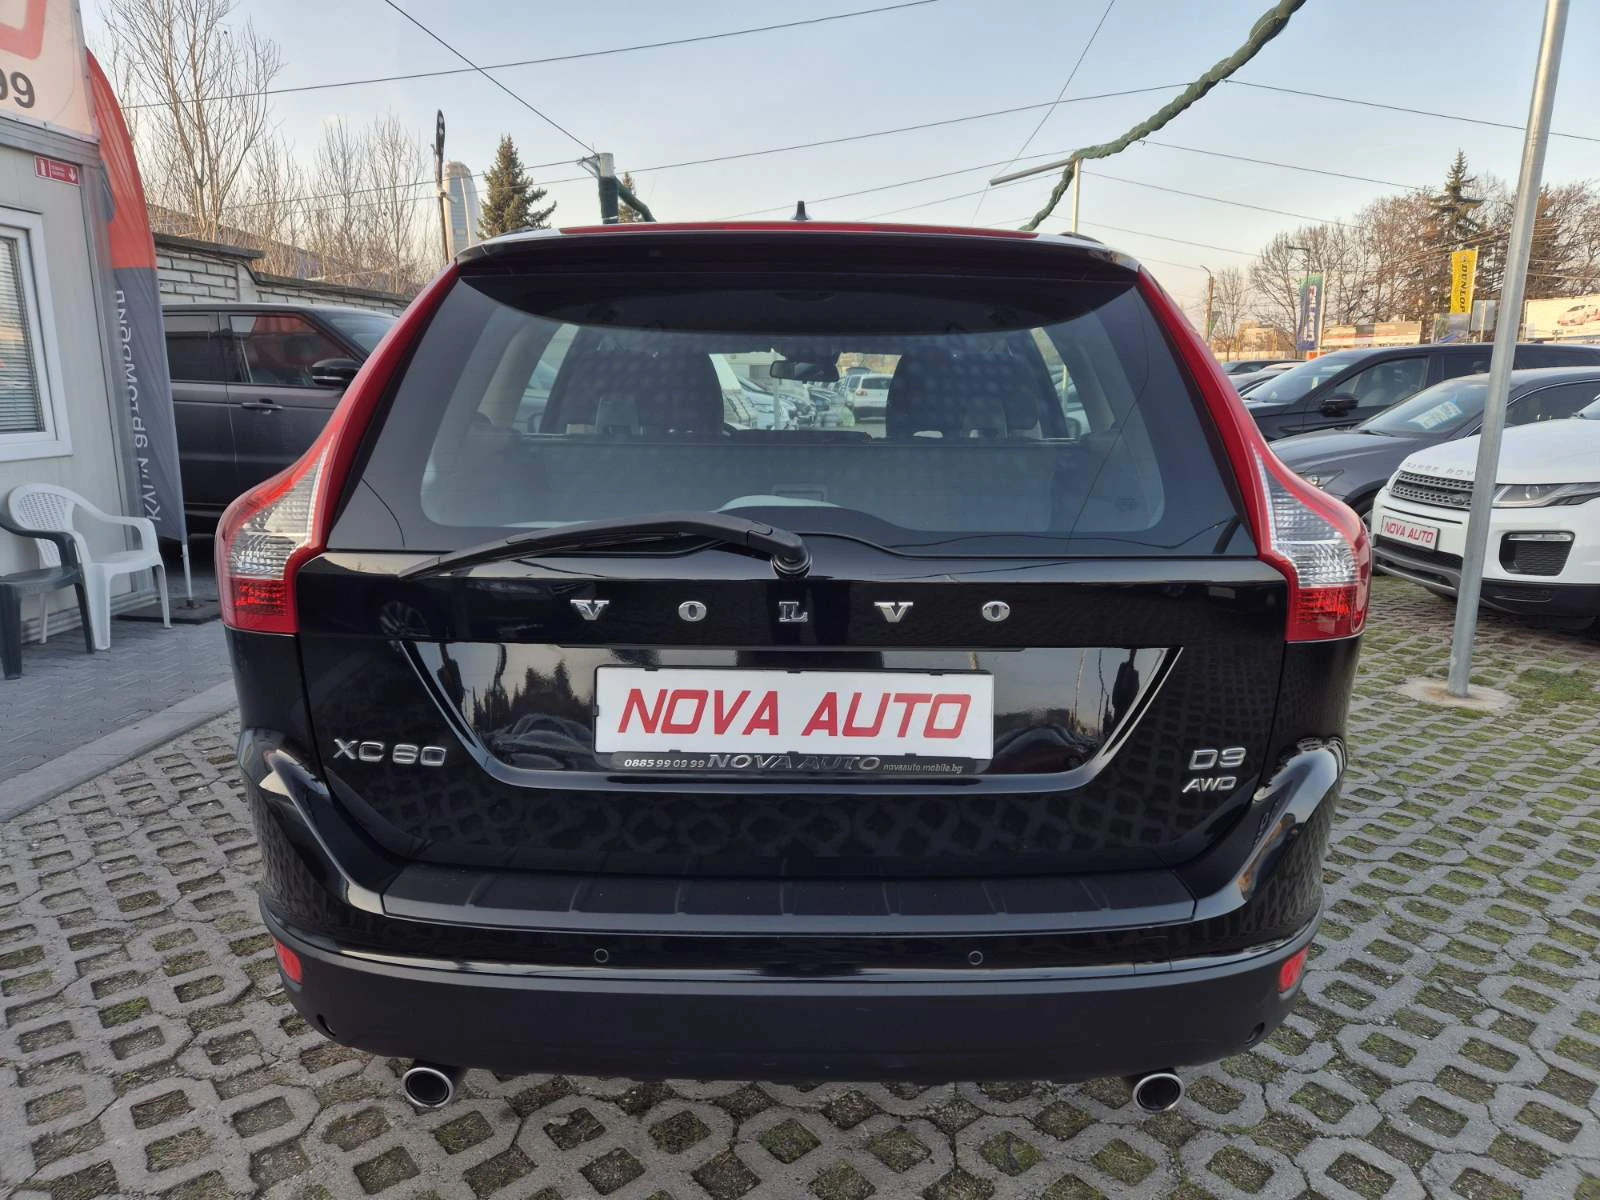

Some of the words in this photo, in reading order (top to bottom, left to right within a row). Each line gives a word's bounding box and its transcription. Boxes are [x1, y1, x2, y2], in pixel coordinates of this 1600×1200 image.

[1460, 263, 1468, 313] DUNLOP
[1384, 521, 1406, 537] NOVA
[1408, 527, 1434, 543] AUTO
[570, 599, 1011, 623] VOLVO
[617, 688, 779, 736] NOVA
[800, 691, 972, 739] AUTO
[624, 759, 654, 768] 0885
[656, 759, 671, 768] 99
[673, 759, 687, 769] 09
[689, 760, 705, 769] 99
[707, 754, 793, 769] NOVA
[798, 756, 881, 771] AUTO
[1182, 776, 1238, 793] AWD
